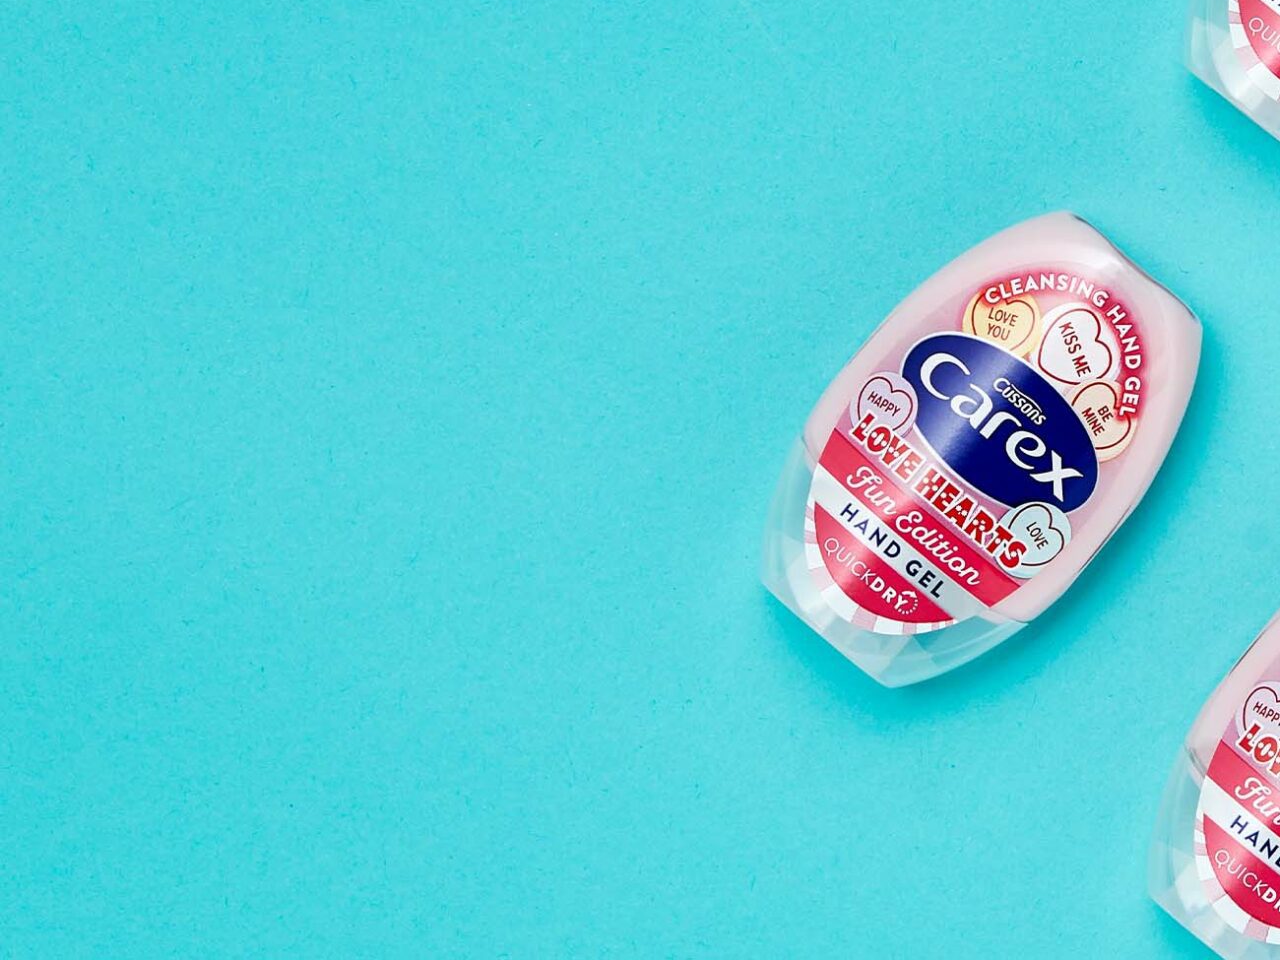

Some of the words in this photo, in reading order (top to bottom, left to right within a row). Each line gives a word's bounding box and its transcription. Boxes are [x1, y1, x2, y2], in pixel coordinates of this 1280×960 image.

[984, 273, 1108, 306] CLEANSING
[988, 308, 1019, 326] LOVE
[988, 323, 1012, 340] YOU
[1106, 304, 1142, 369] HAND
[1059, 322, 1082, 354] KISS
[1073, 354, 1092, 377] ME
[866, 393, 901, 416] HAPPY
[994, 377, 1047, 425] Cussons
[1118, 377, 1140, 418] GEL
[918, 354, 1084, 501] Carex
[850, 415, 924, 480] LOVE
[916, 467, 1027, 569] HEARTS
[845, 466, 898, 514] Fun
[895, 511, 980, 586] Edition
[1025, 523, 1047, 552] LOVE
[840, 504, 902, 558] HAND
[907, 559, 947, 598] GEL
